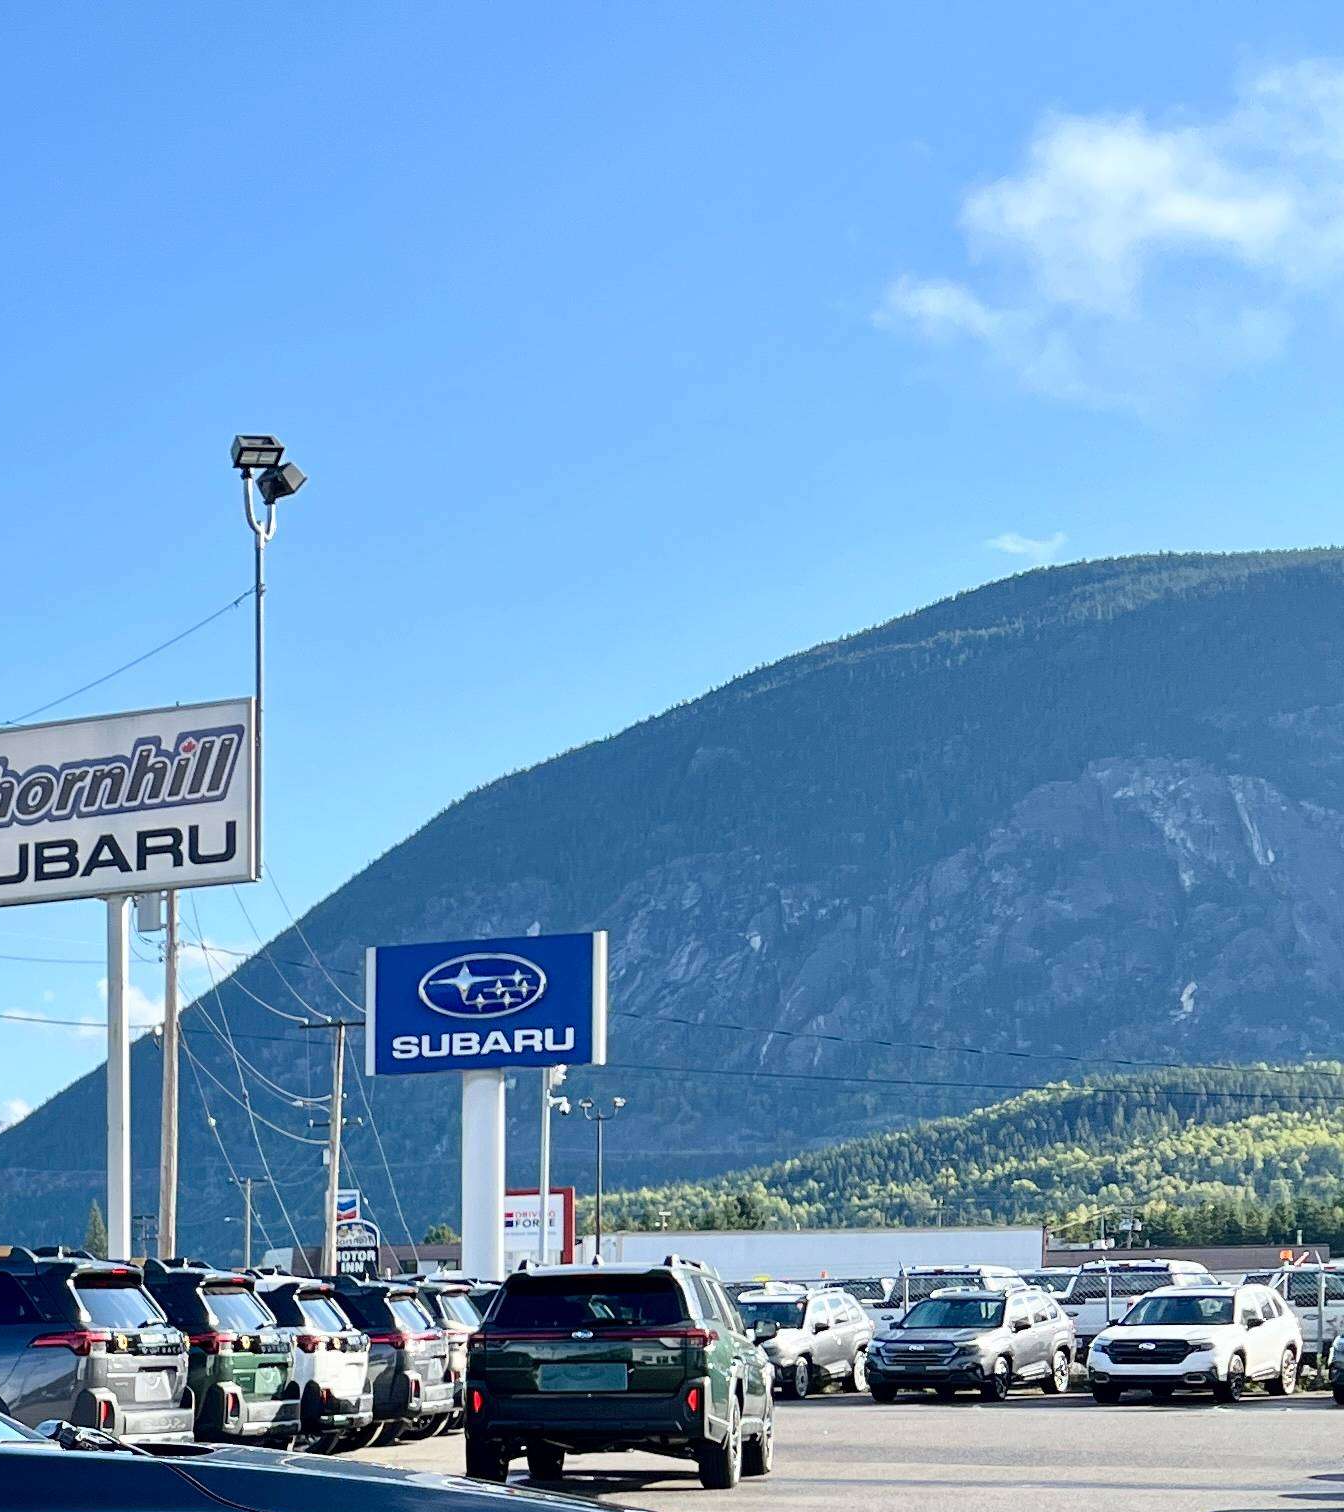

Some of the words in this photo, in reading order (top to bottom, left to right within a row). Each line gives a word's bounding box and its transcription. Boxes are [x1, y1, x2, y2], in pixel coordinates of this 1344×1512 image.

[392, 1027, 574, 1059] SUBARU
[515, 1219, 556, 1228] FORE
[341, 1262, 364, 1273] INN
